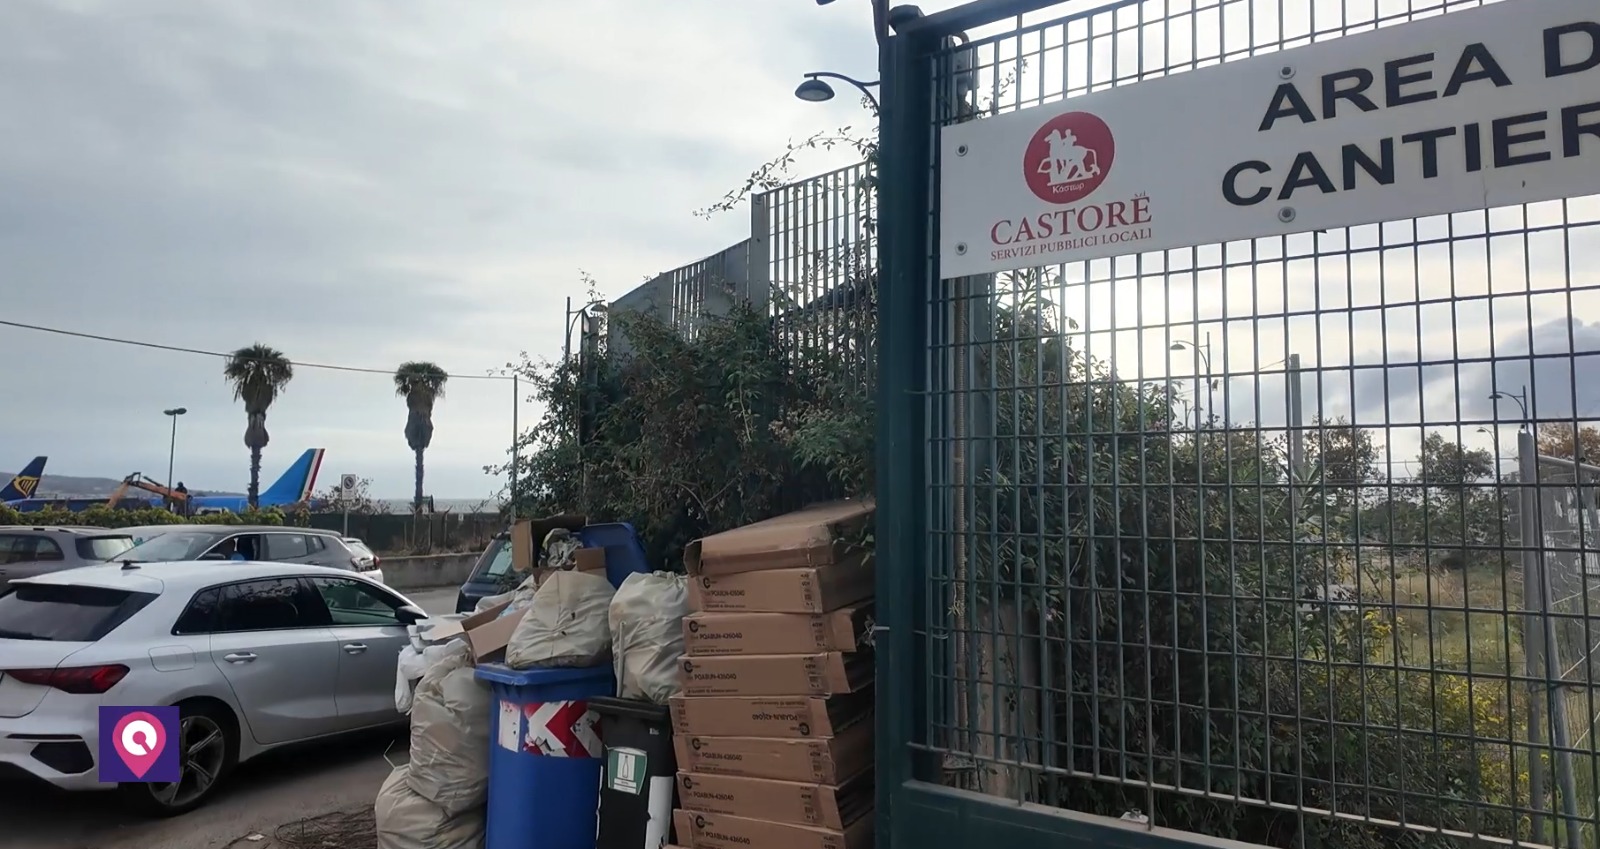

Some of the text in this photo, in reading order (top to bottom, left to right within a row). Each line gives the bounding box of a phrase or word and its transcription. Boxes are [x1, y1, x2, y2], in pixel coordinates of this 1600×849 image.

[1258, 42, 1513, 132] AREA
[990, 196, 1152, 246] CASTORE
[990, 227, 1152, 261] SERVIZI PUBBLICI LOCALI
